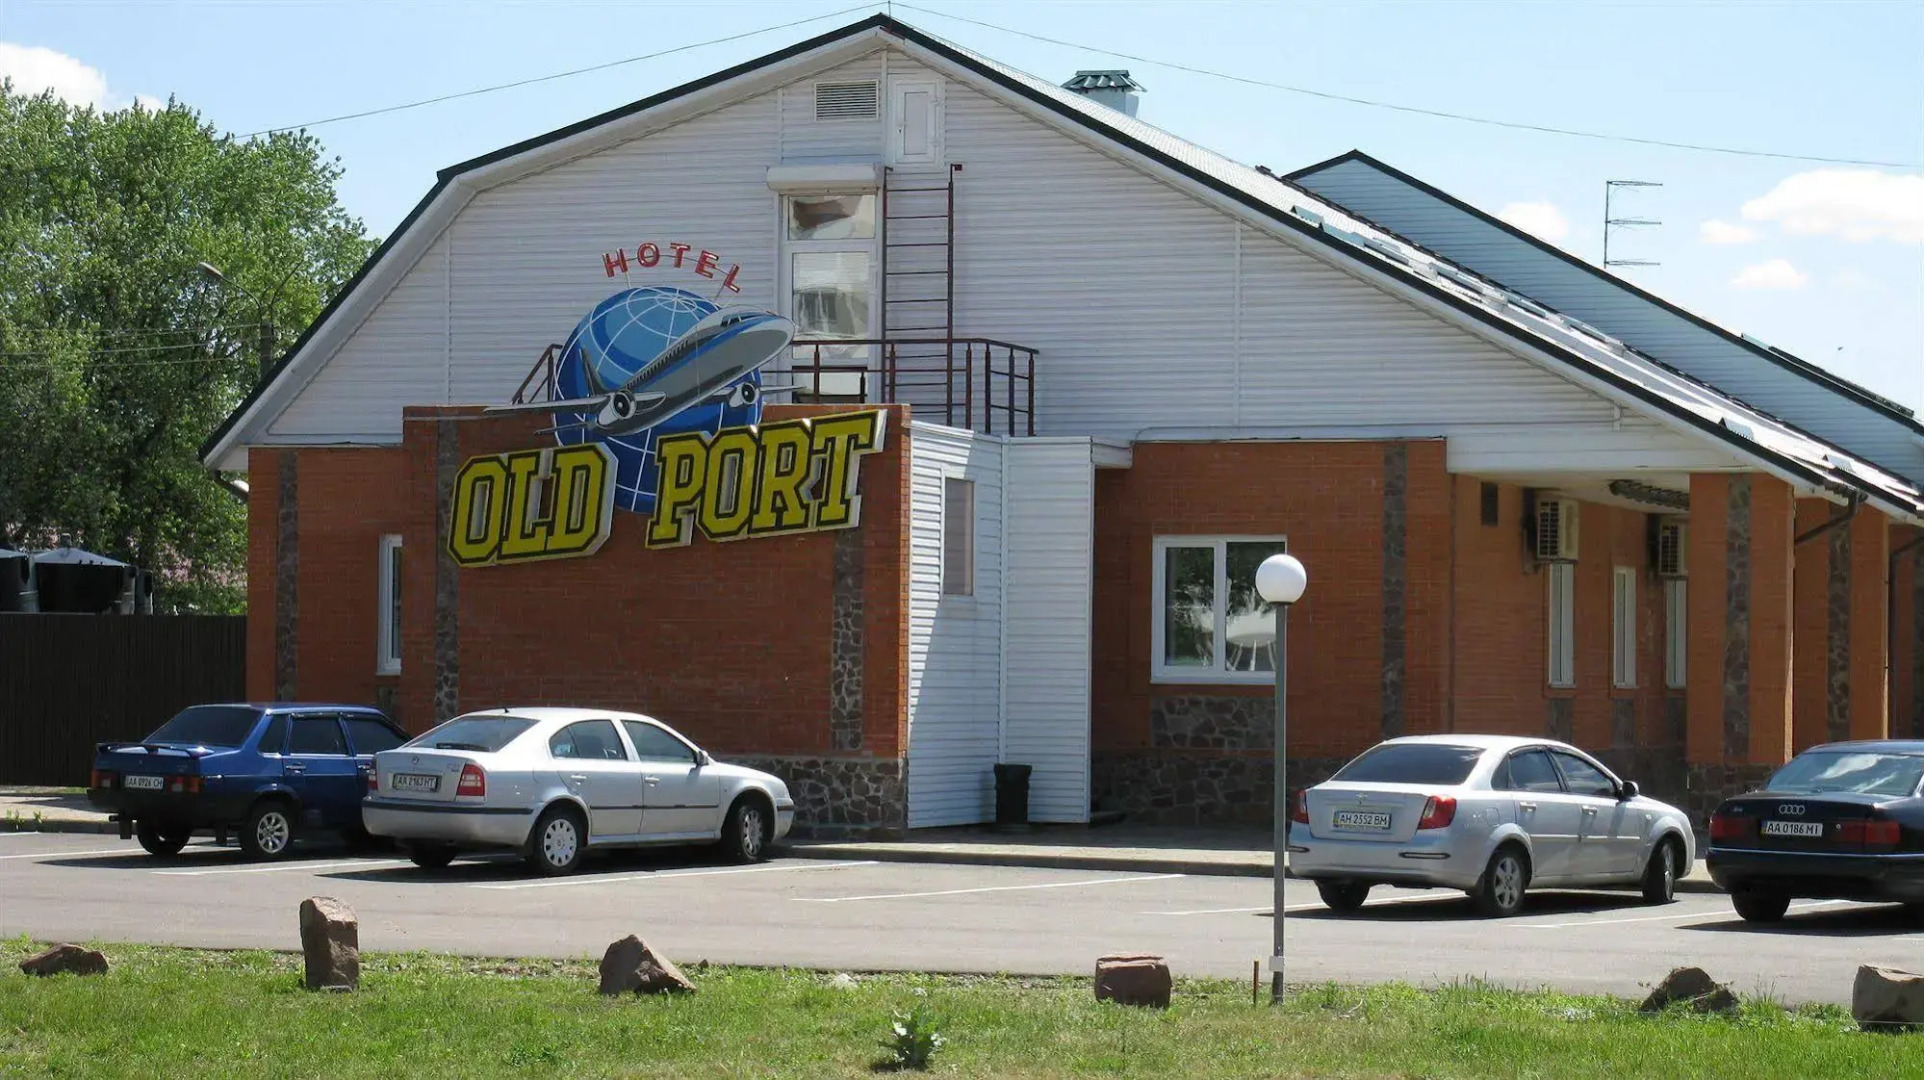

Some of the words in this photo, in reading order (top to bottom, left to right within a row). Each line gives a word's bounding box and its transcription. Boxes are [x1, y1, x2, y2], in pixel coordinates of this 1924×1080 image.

[602, 243, 742, 294] HOTEL
[447, 442, 618, 568] OLD
[645, 408, 888, 551] PORT
[1340, 814, 1351, 824] AH
[1353, 815, 1372, 825] 2552
[1374, 816, 1387, 826] BM
[1767, 823, 1780, 833] AA
[1783, 824, 1804, 835] 0186
